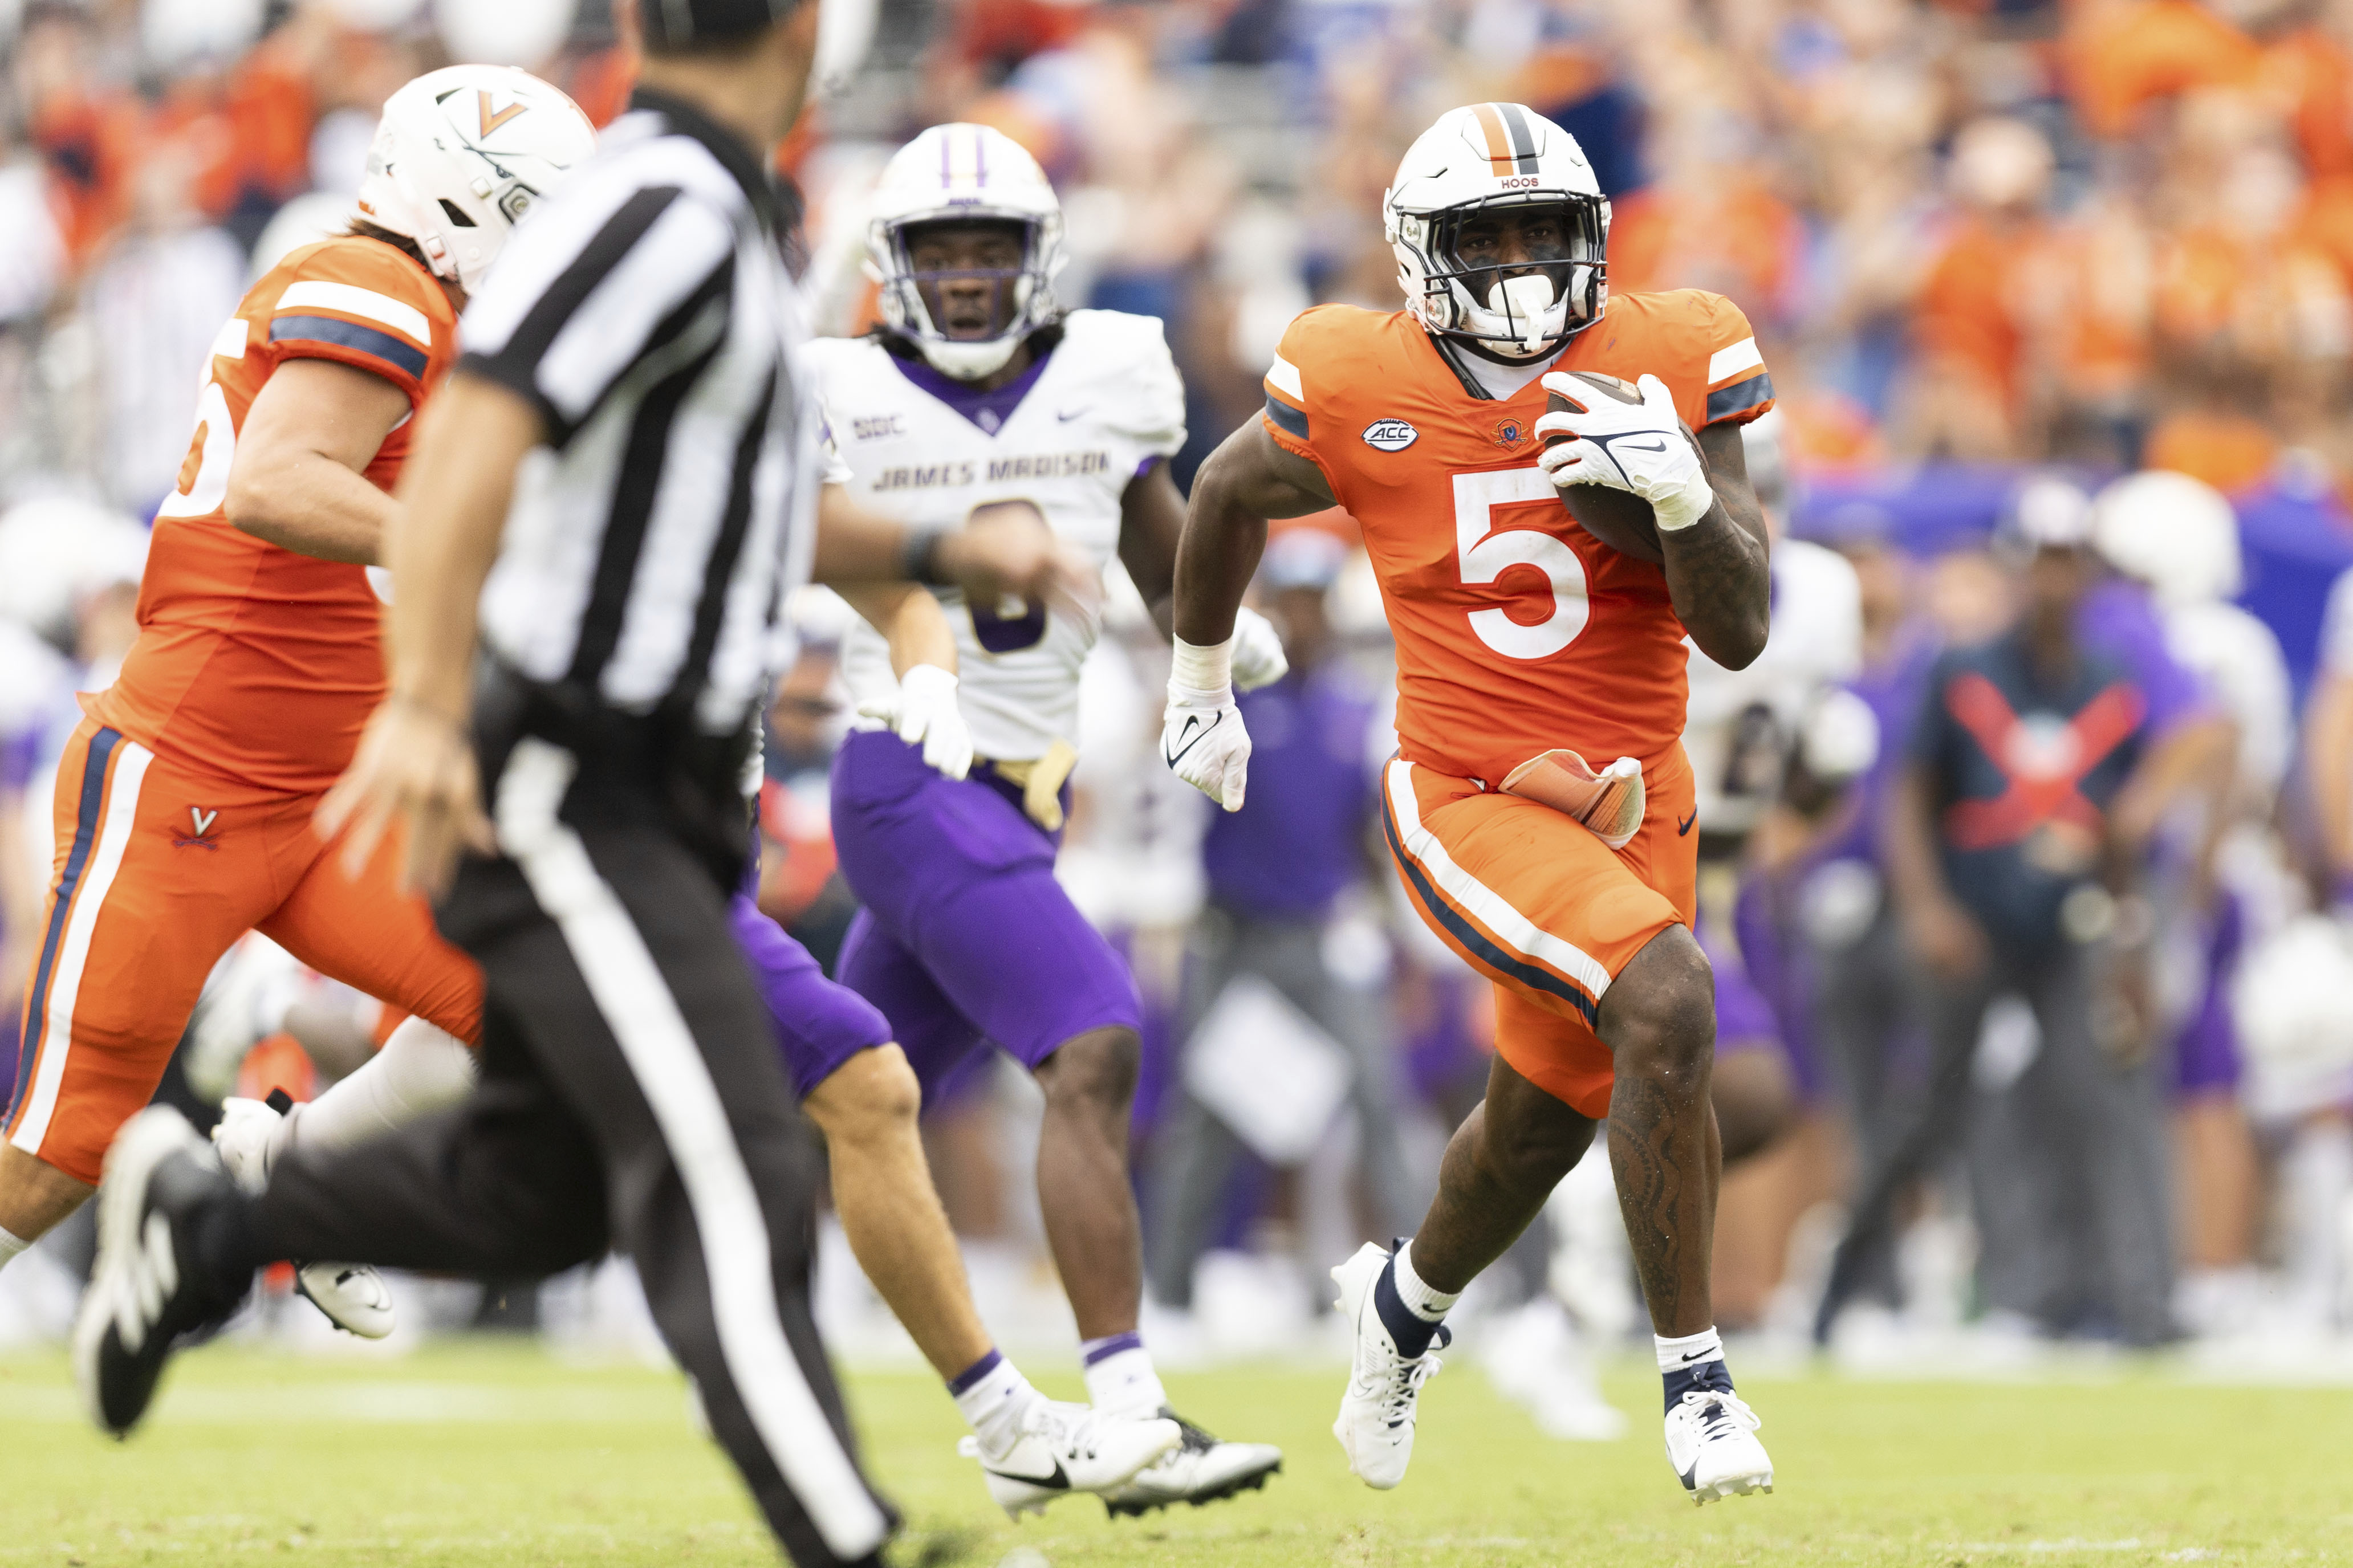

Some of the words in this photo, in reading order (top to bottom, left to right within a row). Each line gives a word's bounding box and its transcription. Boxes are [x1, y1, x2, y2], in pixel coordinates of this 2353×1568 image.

[1501, 177, 1539, 189] HOOS
[1370, 427, 1411, 438] ACC
[872, 462, 975, 492] JAMES
[987, 453, 1111, 482] MADISON
[1452, 466, 1590, 659] 5
